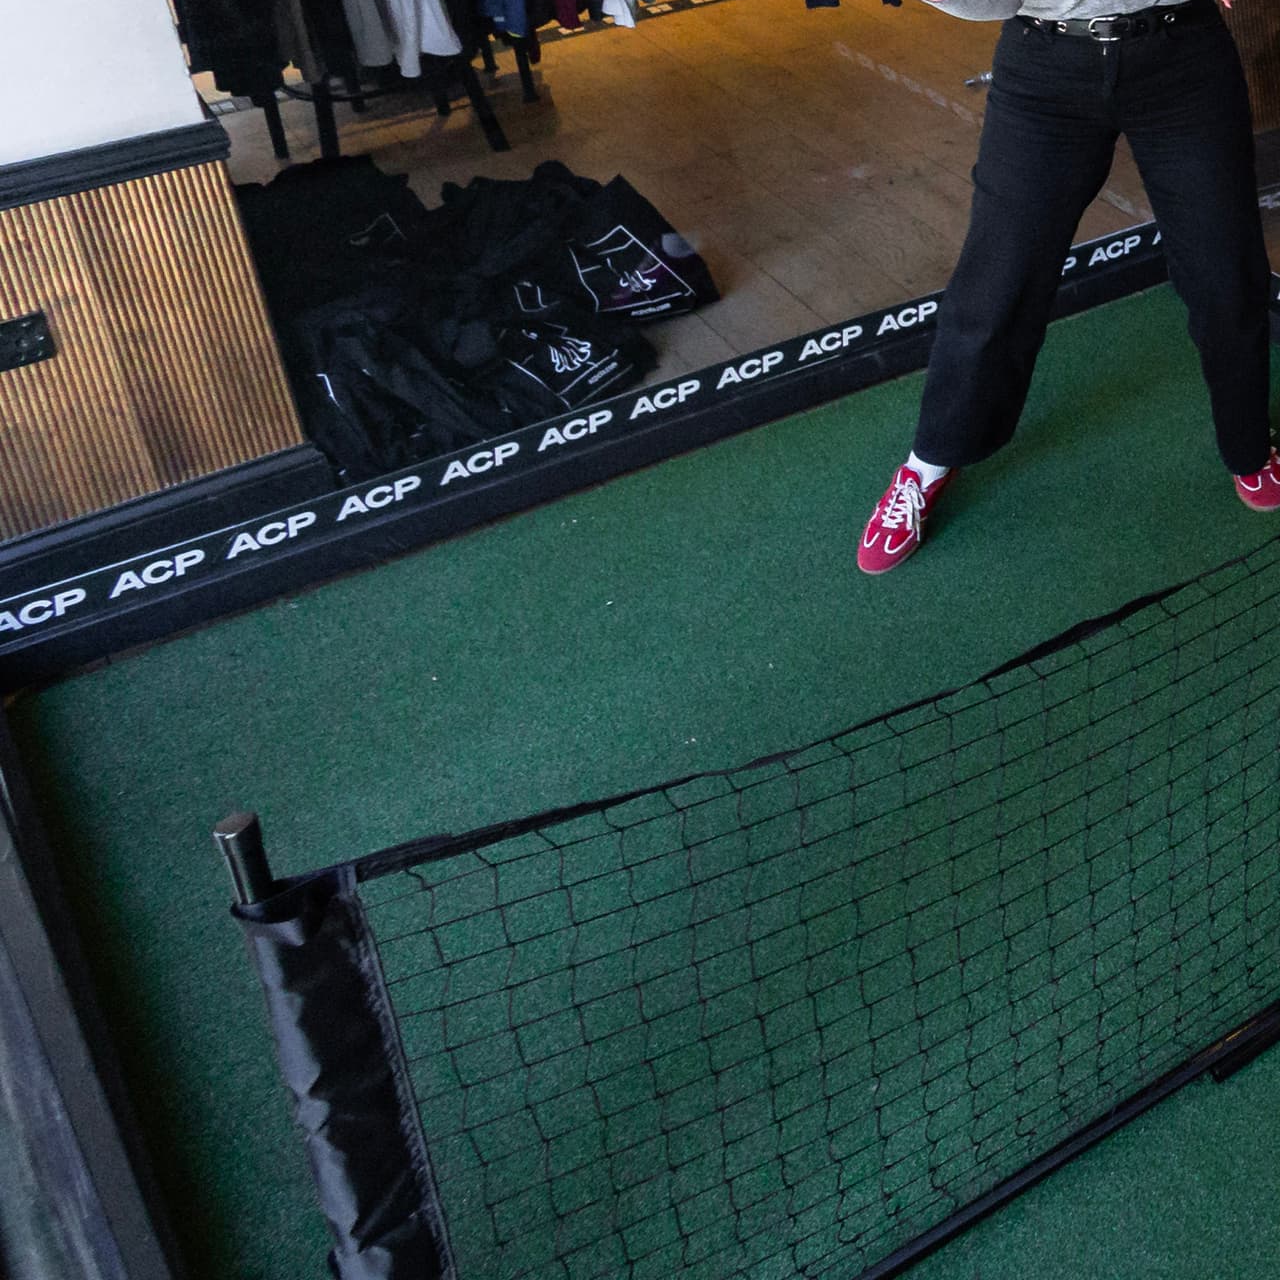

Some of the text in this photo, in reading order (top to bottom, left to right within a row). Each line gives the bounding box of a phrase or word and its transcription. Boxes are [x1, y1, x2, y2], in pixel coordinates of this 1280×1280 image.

[0, 588, 87, 633] ACP
[109, 549, 206, 599] ACP
[226, 511, 317, 560] ACP
[336, 475, 422, 521] ACP
[439, 441, 520, 486] ACP
[537, 409, 613, 453] ACP
[629, 379, 701, 421] ACP
[716, 351, 784, 390] ACP
[798, 325, 863, 361] ACP
[876, 301, 938, 336] ACP
[1088, 234, 1142, 267] ACP
